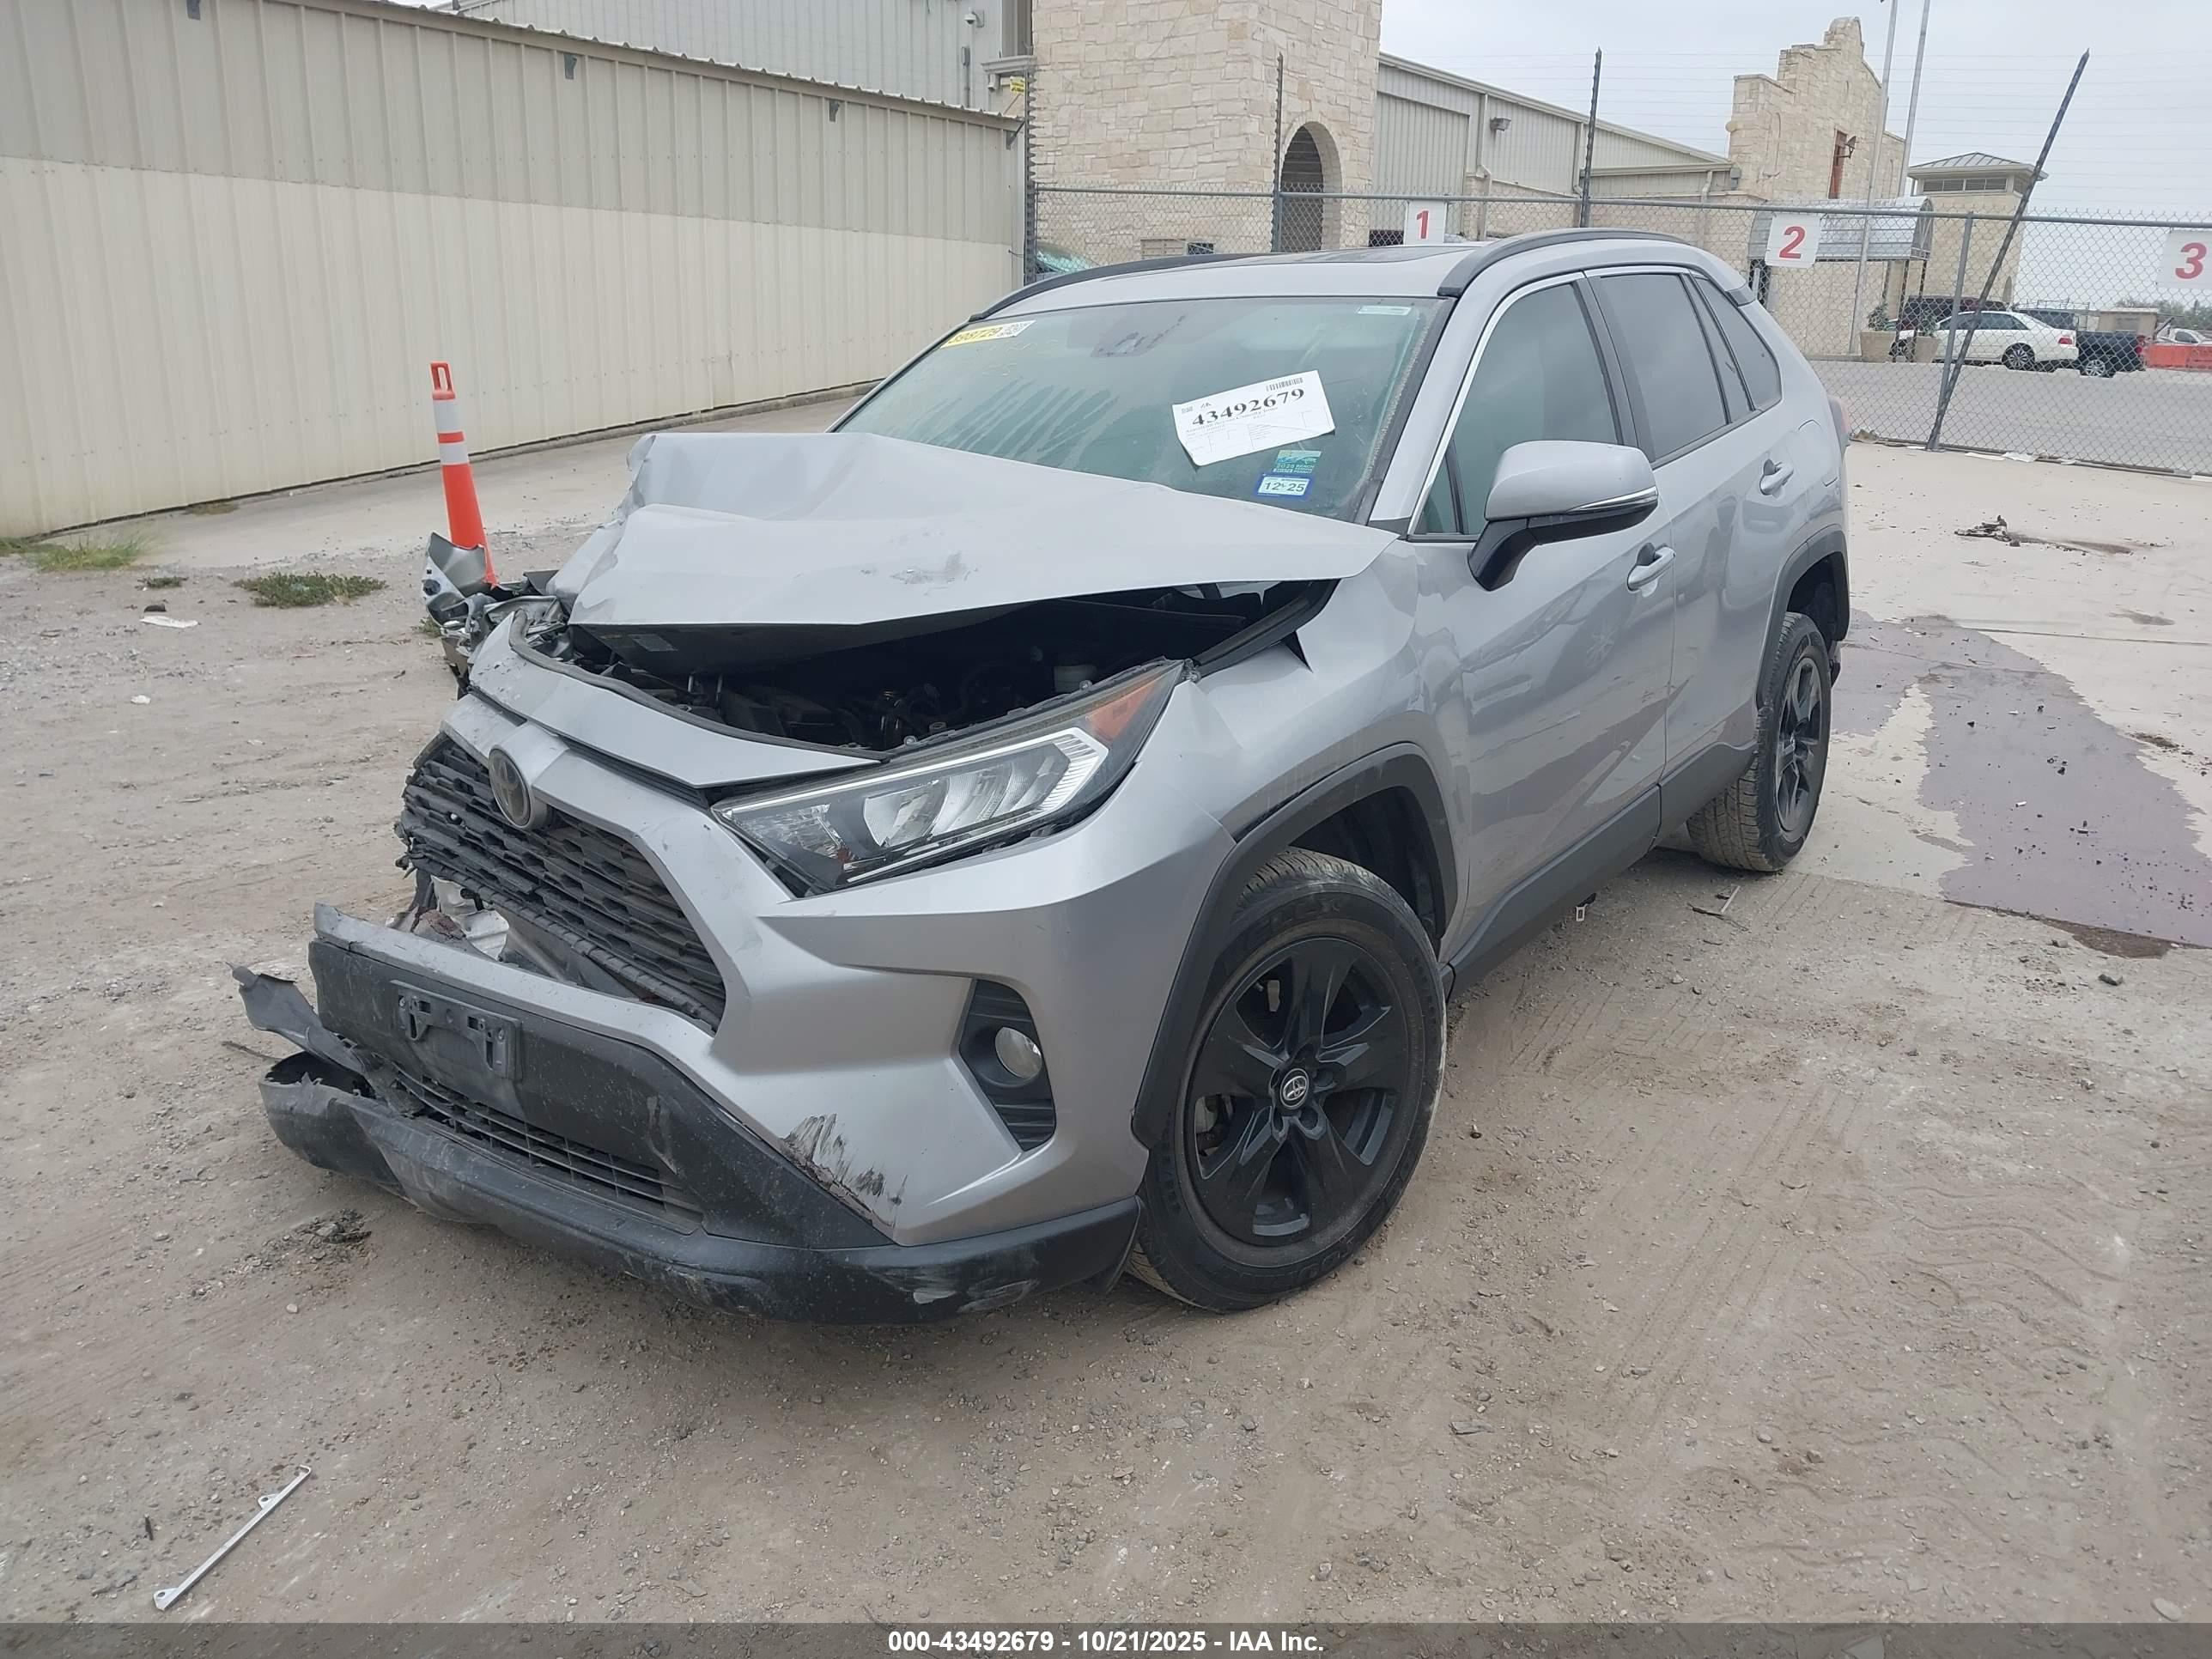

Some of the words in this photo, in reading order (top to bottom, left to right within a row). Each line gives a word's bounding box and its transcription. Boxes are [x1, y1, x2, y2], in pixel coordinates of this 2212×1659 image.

[1416, 210, 1429, 239] 1
[1779, 226, 1806, 258] 2
[2175, 242, 2207, 279] 3
[1193, 388, 1304, 425] 43492679
[1265, 482, 1281, 490] 12
[1286, 483, 1305, 492] 25
